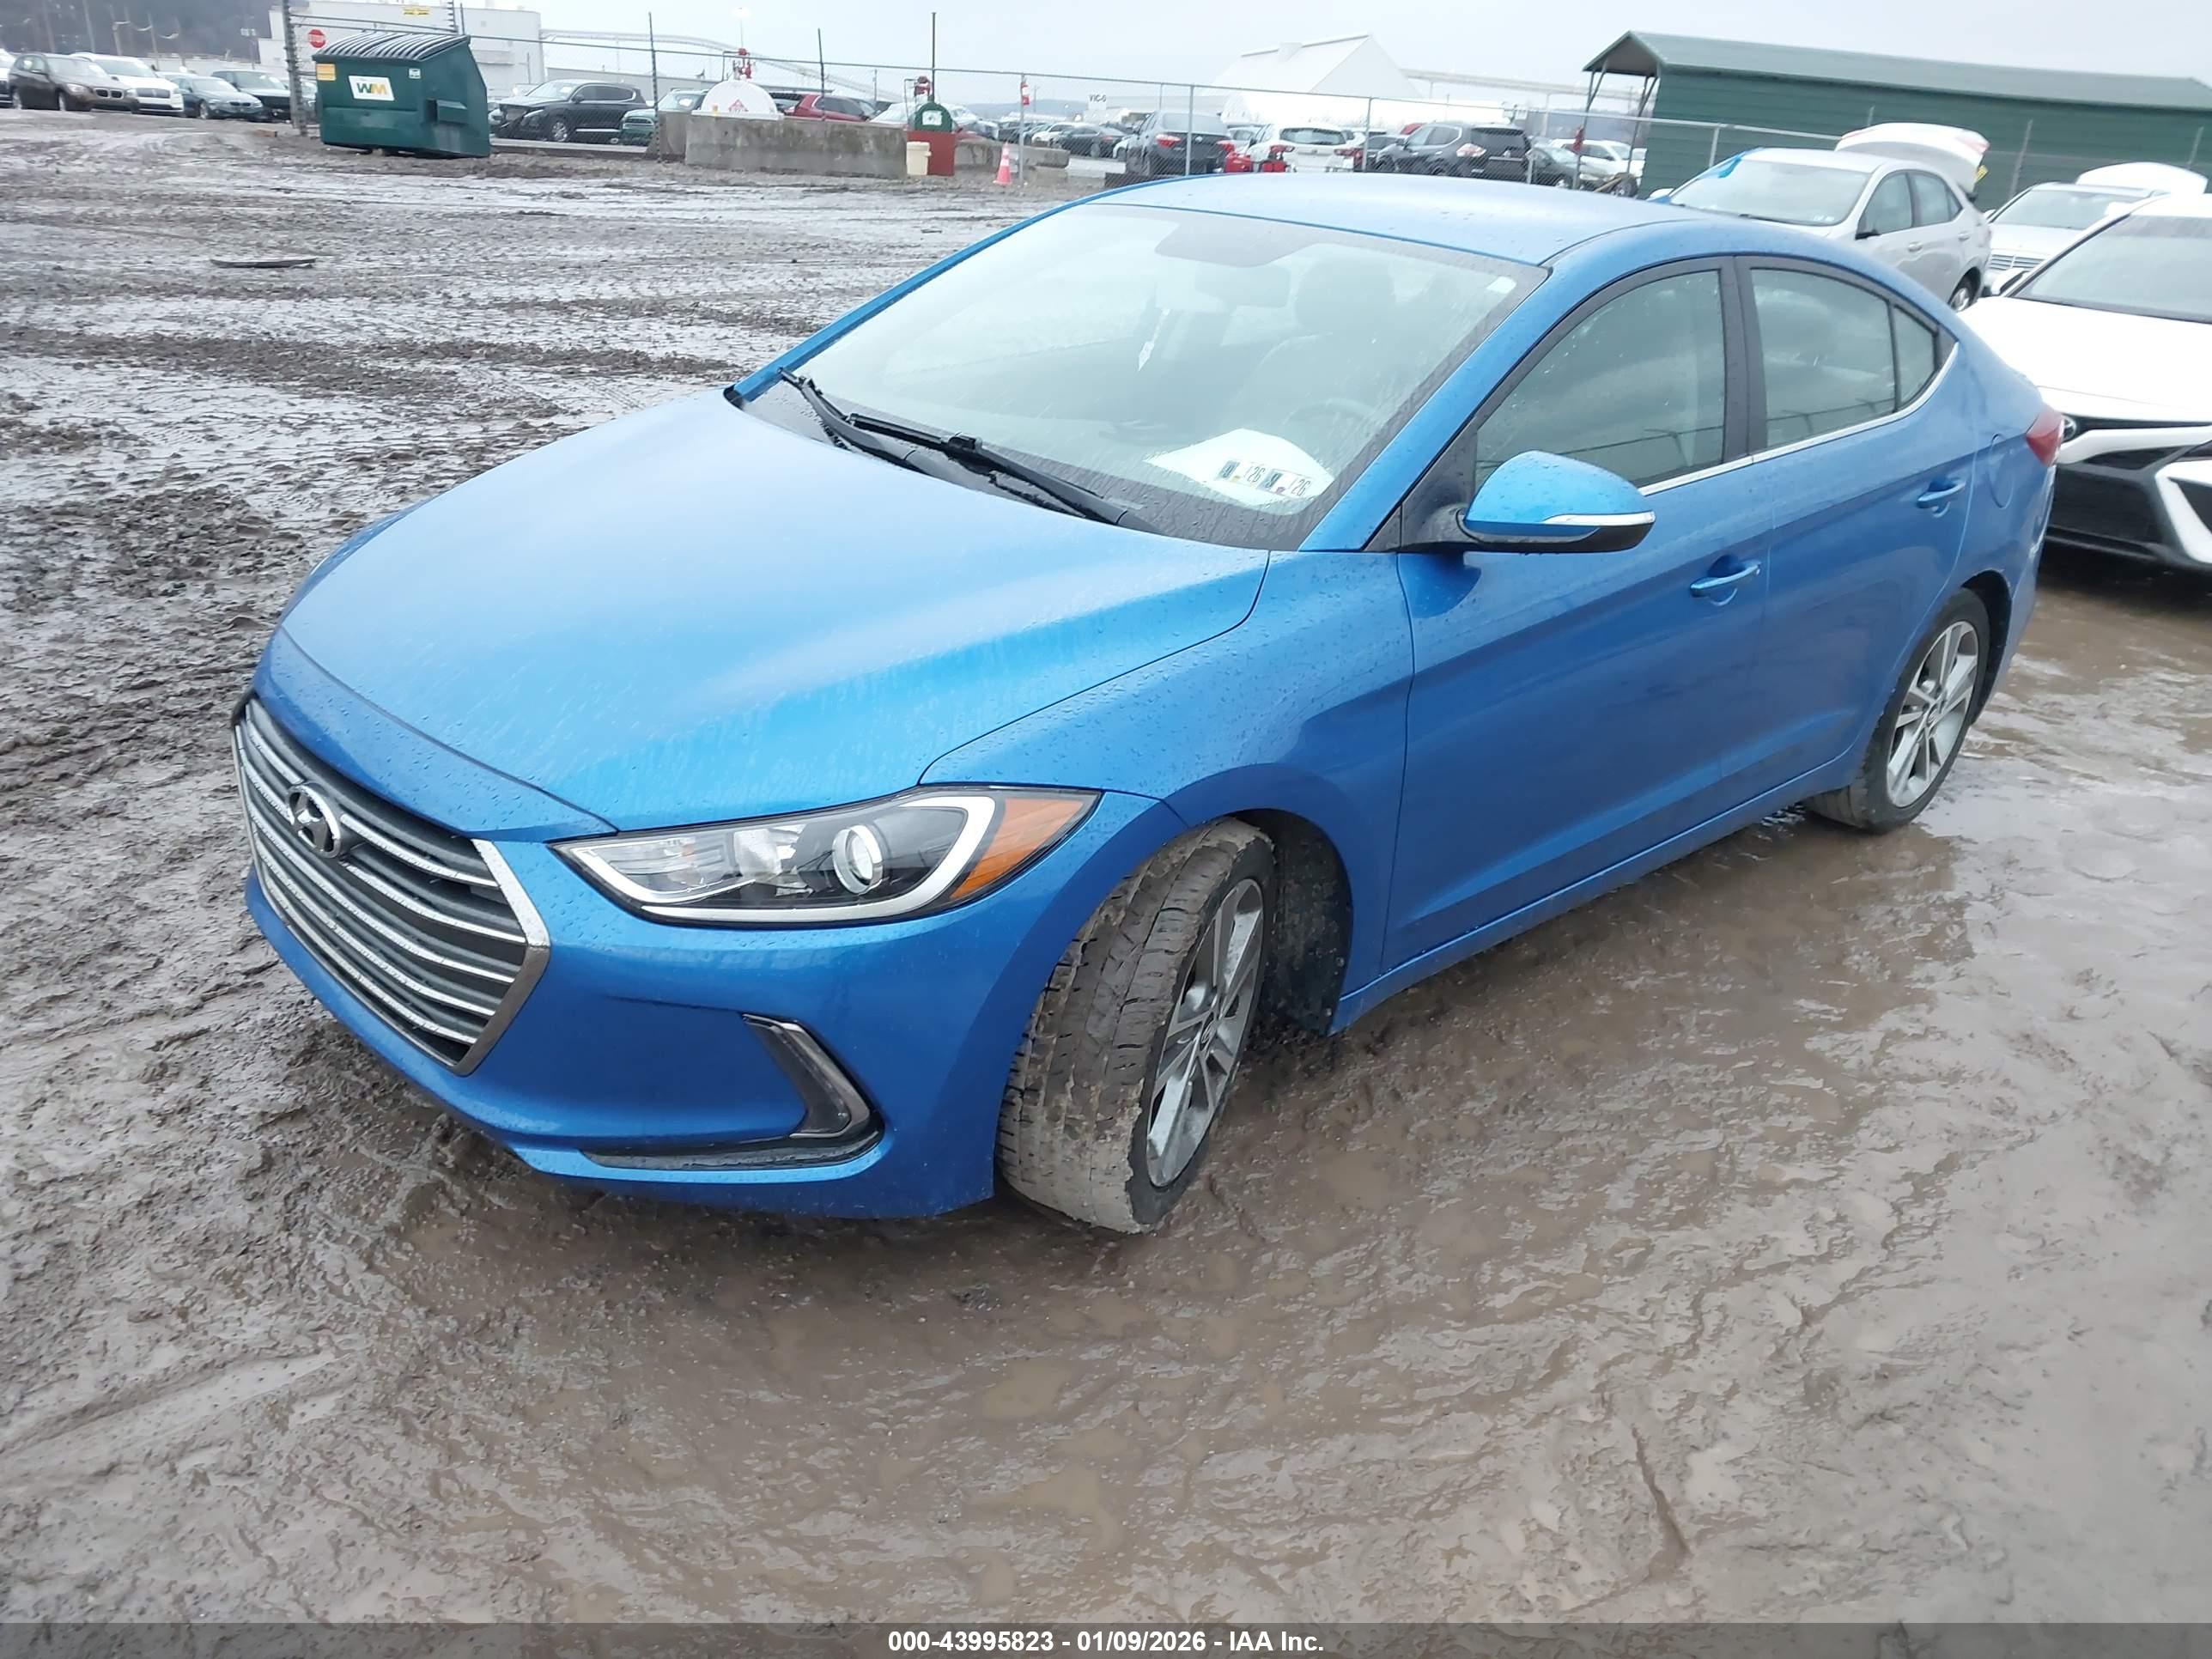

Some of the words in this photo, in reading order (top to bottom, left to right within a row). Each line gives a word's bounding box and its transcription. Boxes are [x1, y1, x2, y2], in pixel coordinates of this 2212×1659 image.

[356, 82, 387, 95] WM
[1247, 465, 1266, 483] 26
[1291, 478, 1311, 495] 26
